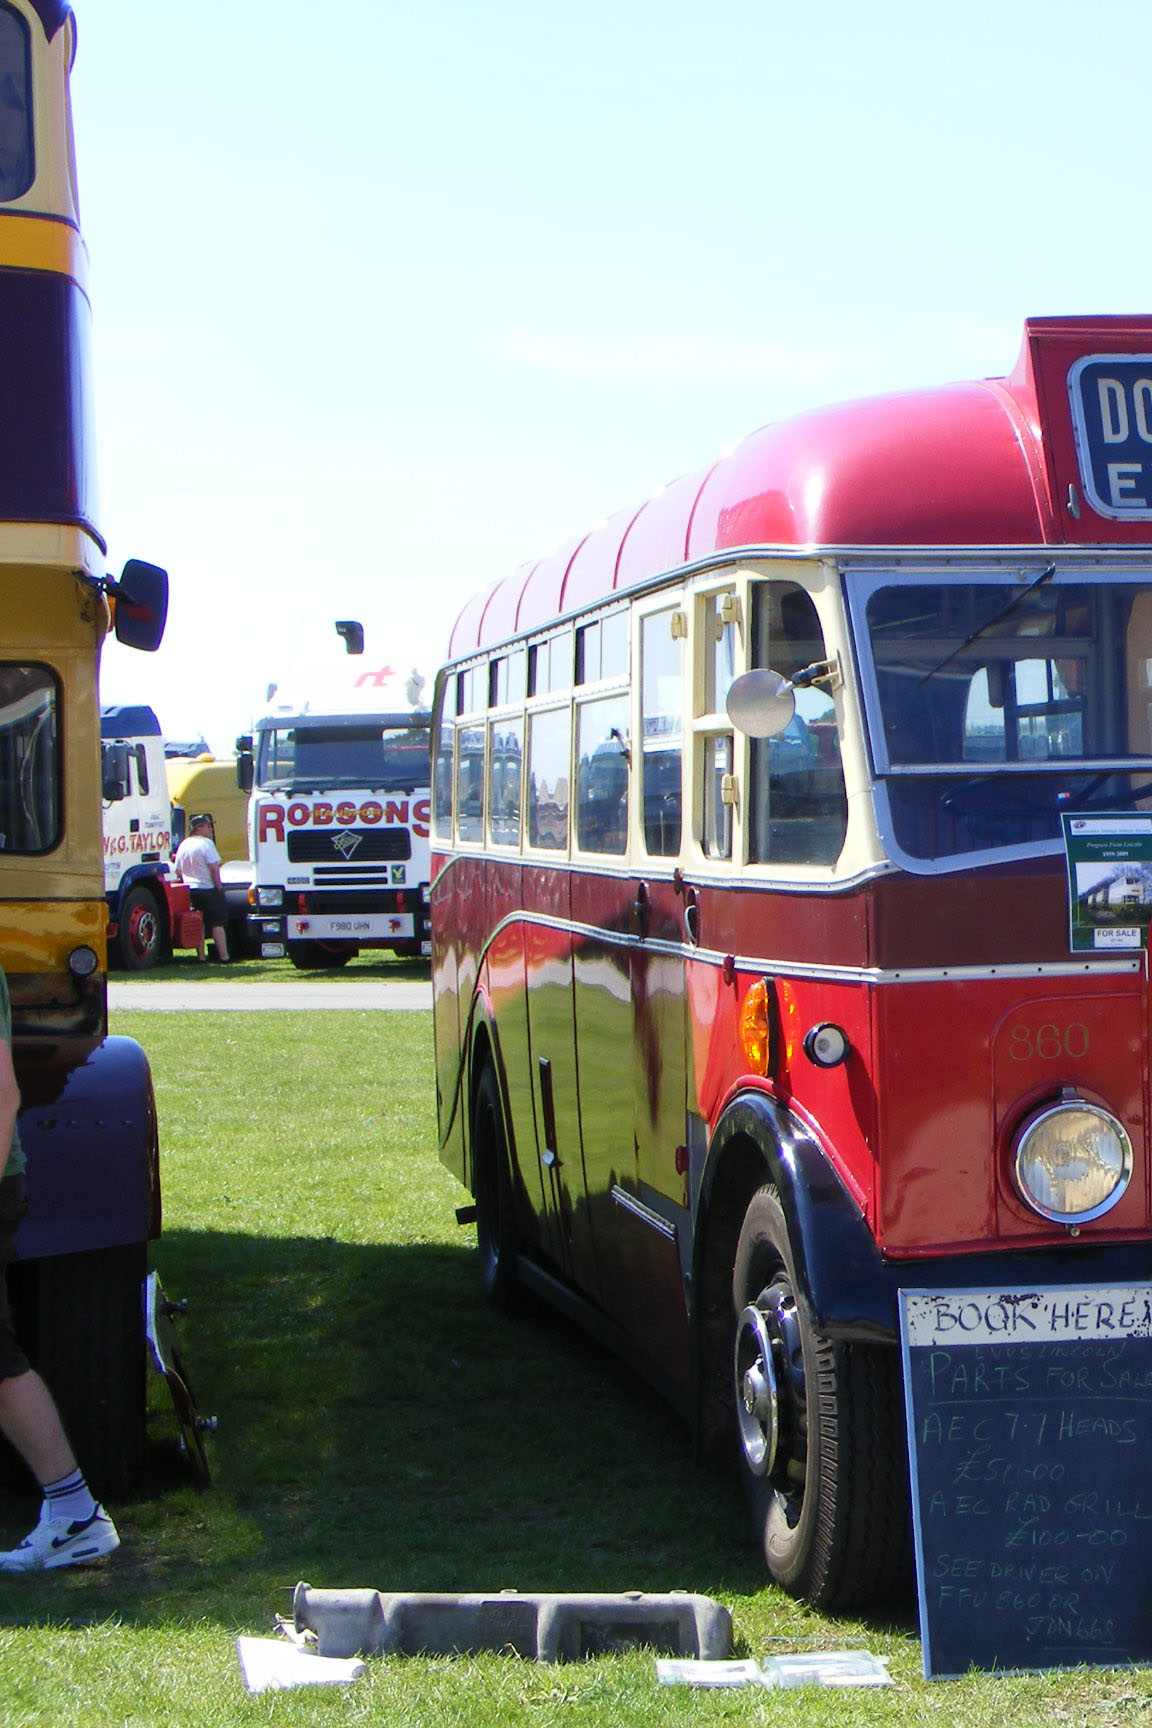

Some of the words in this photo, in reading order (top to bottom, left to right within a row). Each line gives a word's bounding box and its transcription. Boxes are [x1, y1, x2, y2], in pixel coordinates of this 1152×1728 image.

[259, 799, 431, 842] ROBSONS
[130, 831, 171, 853] TAYLOR
[1116, 929, 1137, 937] SALE
[1008, 1022, 1090, 1062] 860
[934, 1301, 1037, 1332] BOOK
[930, 1351, 1031, 1396] PARTS
[1046, 1367, 1093, 1391] FOR
[922, 1412, 993, 1444] AEC
[1059, 1409, 1137, 1444] HEADS
[929, 1489, 991, 1517] AEC
[1005, 1490, 1052, 1514] RAD
[933, 1553, 983, 1580] SEE
[990, 1556, 1070, 1585] DRIVER
[1081, 1560, 1115, 1584] ON
[939, 1585, 986, 1608] FFU
[995, 1589, 1041, 1611] 860
